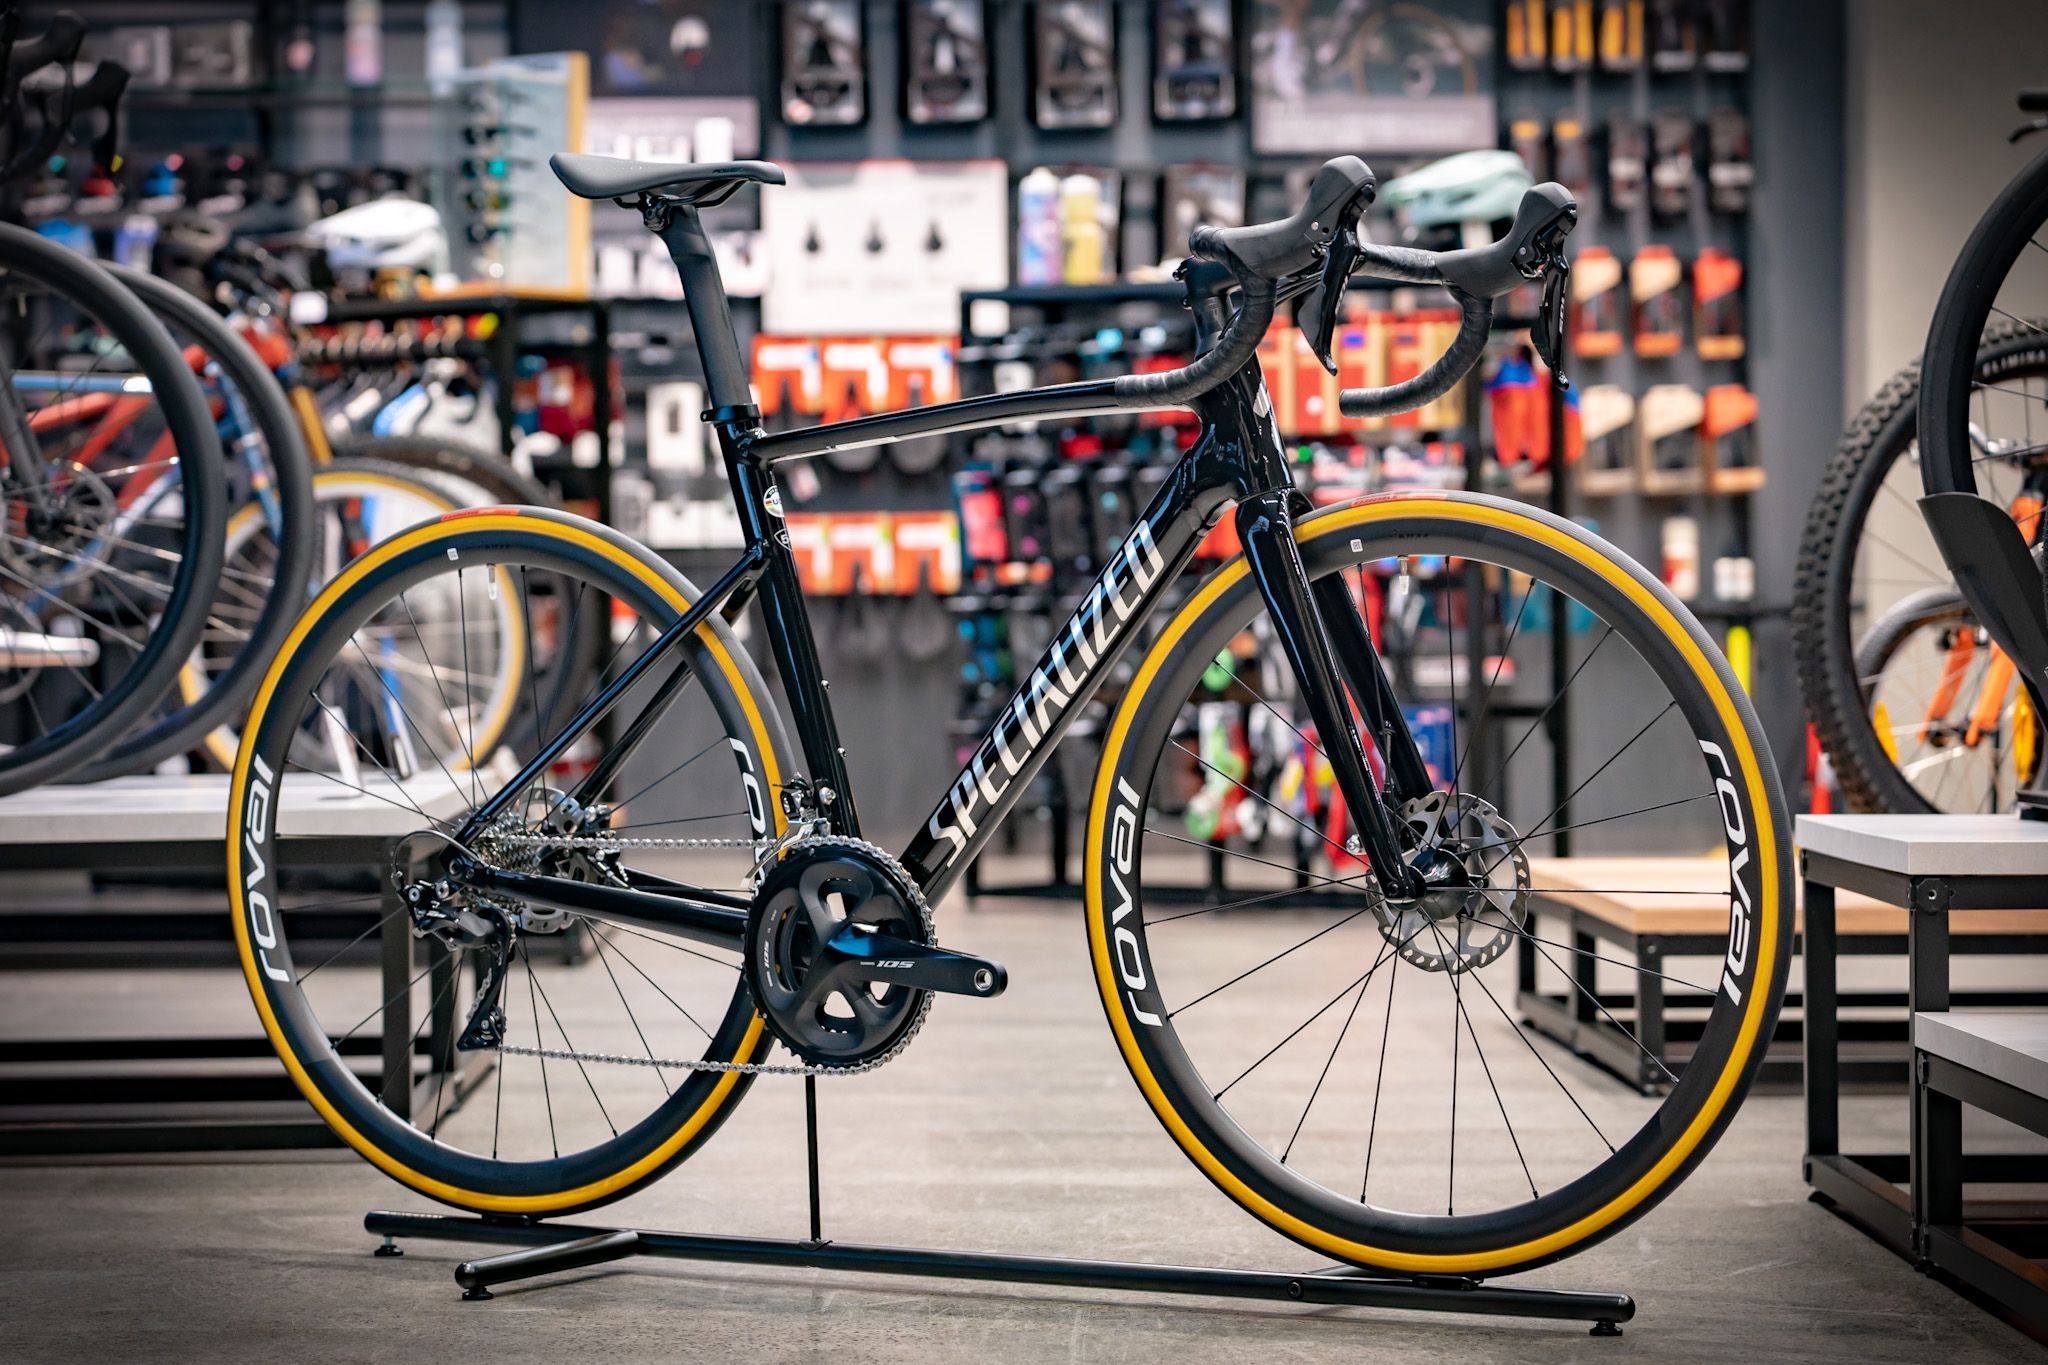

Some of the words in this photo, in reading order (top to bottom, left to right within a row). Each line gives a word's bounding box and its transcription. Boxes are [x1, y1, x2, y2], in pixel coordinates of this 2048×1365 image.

[928, 519, 1165, 868] SPECIALIZED
[245, 753, 291, 983] roval
[876, 960, 916, 969] 105
[1109, 775, 1163, 1027] roval
[1698, 739, 1751, 1007] roval
